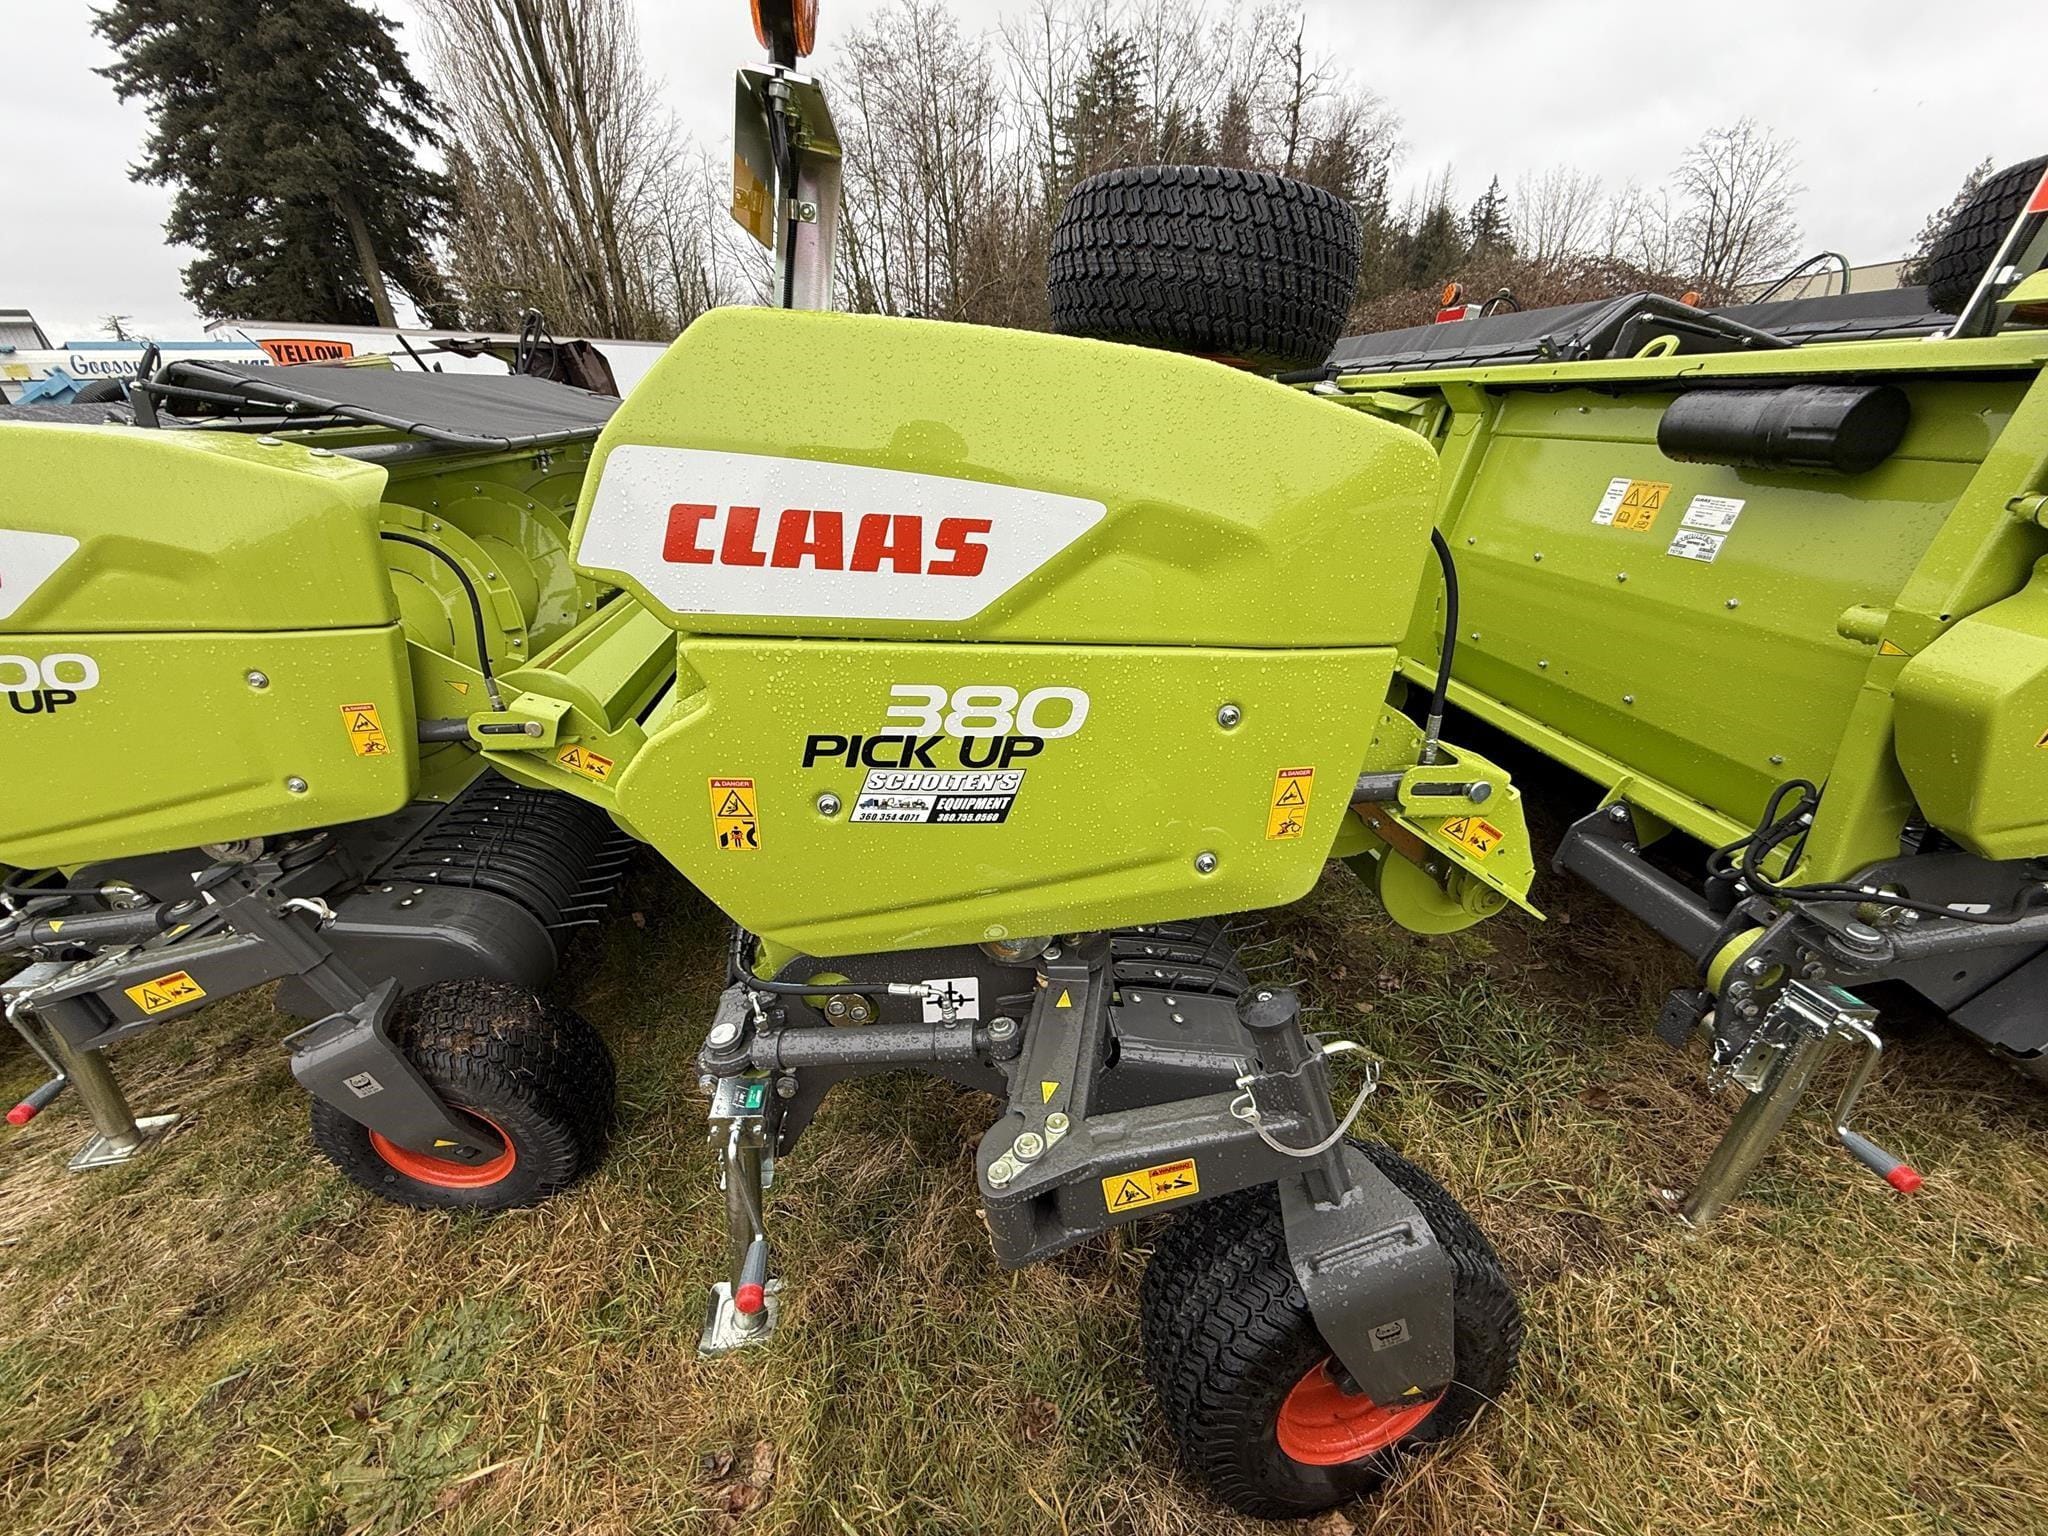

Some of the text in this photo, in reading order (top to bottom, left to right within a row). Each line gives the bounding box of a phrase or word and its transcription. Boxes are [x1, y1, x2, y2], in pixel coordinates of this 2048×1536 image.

[270, 344, 343, 362] YELLOW
[662, 503, 993, 577] CLAAS
[8, 689, 77, 715] UP
[880, 684, 1090, 739] 380
[802, 735, 1044, 769] PICK UP
[867, 772, 1019, 792] SCHOLTEN'S
[1287, 769, 1311, 777] DANGER
[935, 796, 1011, 811] EQUIPMENT
[859, 812, 920, 822] 360.354.4071
